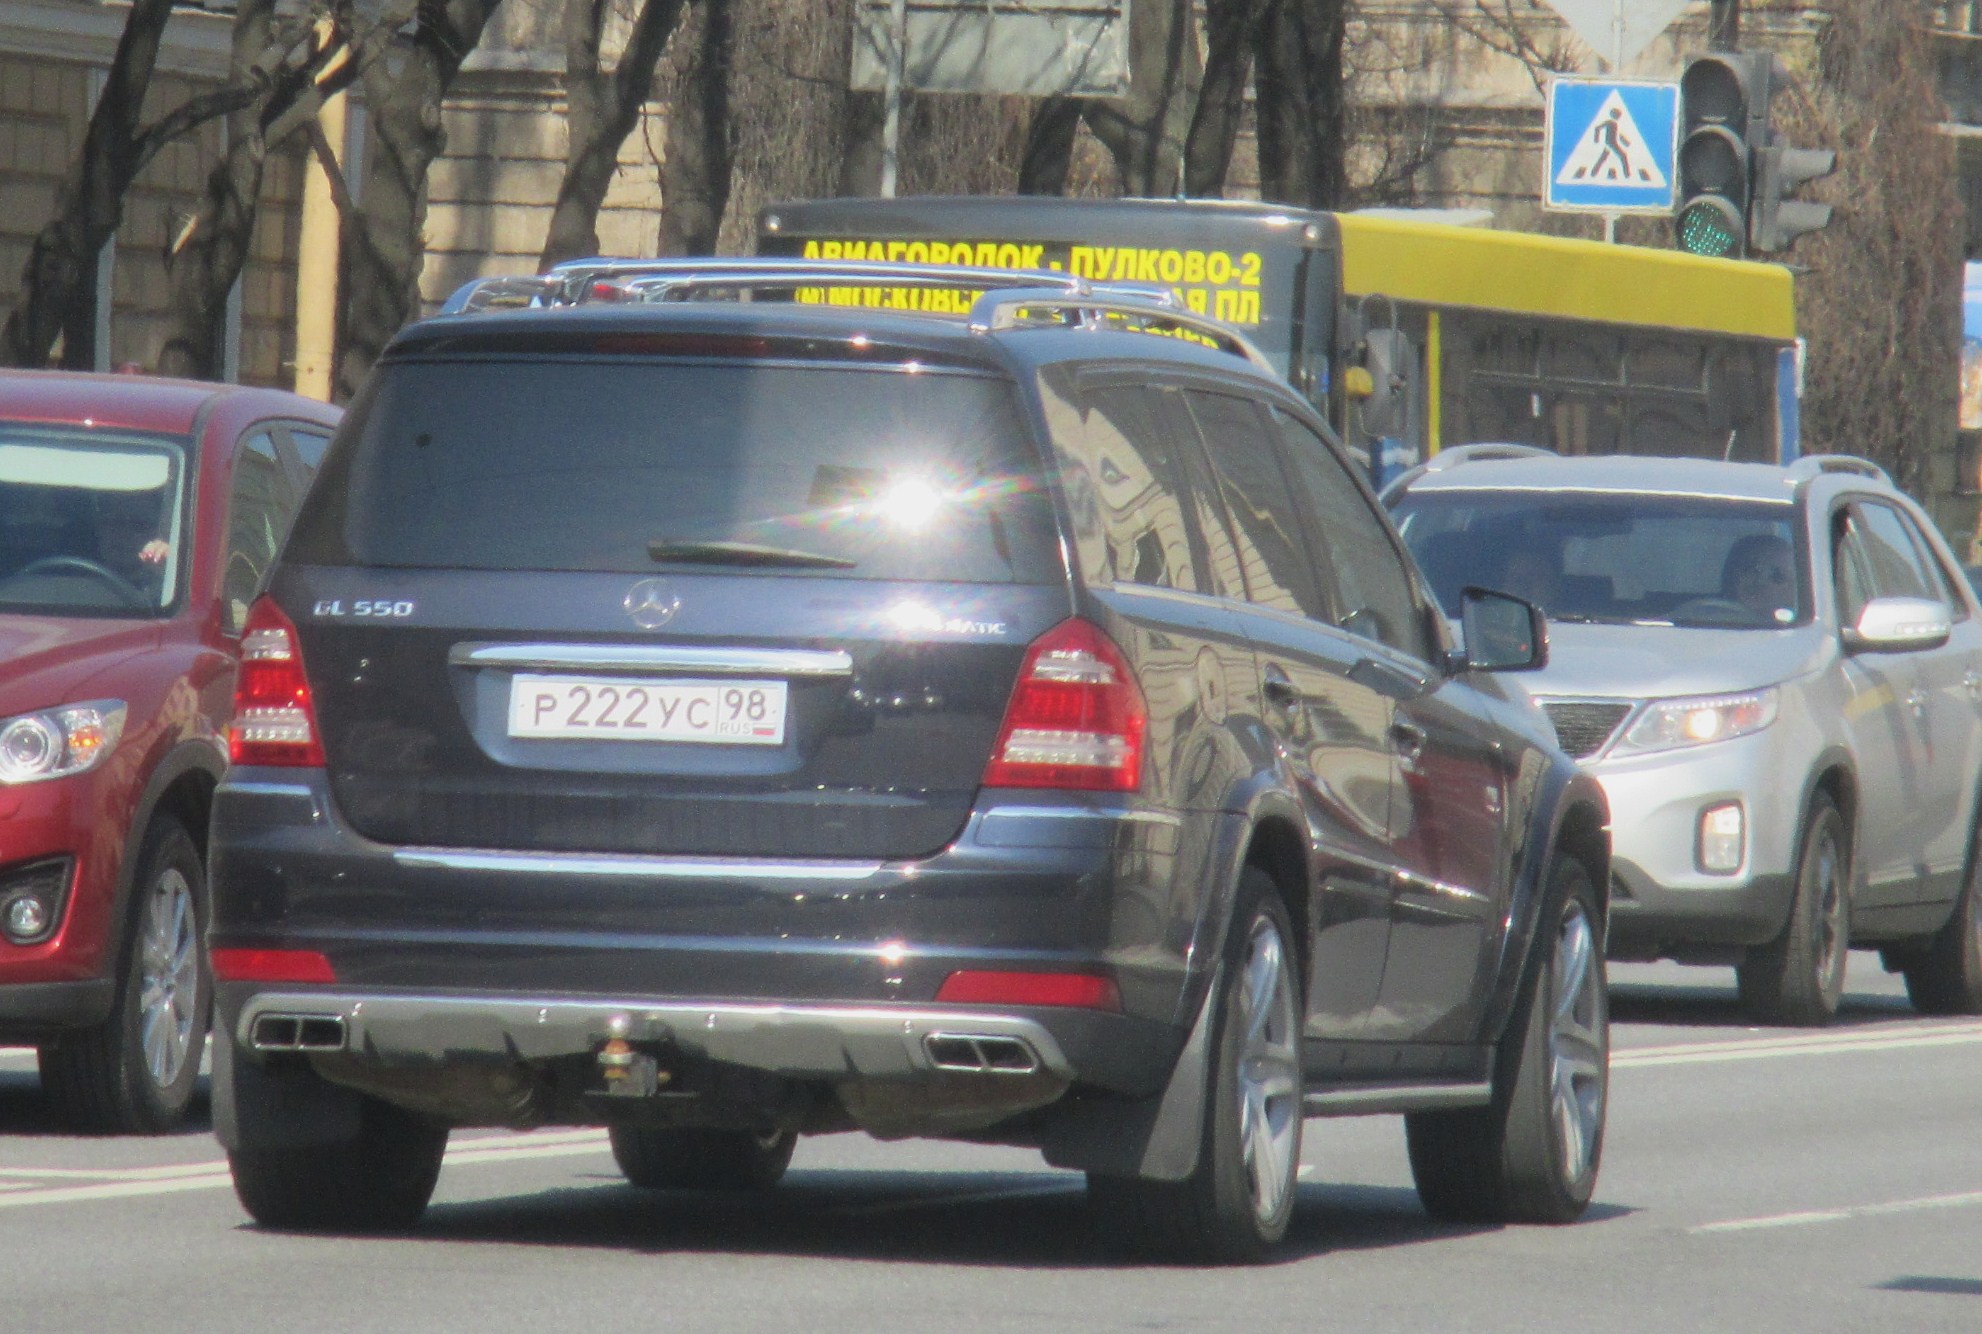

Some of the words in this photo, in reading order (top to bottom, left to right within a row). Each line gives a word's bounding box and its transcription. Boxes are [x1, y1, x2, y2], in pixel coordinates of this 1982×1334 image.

[1069, 245, 1262, 286] ПУЛКОВО-2
[313, 600, 345, 616] GL
[353, 600, 413, 617] 550
[725, 688, 767, 721] 98
[719, 722, 752, 735] RUS
